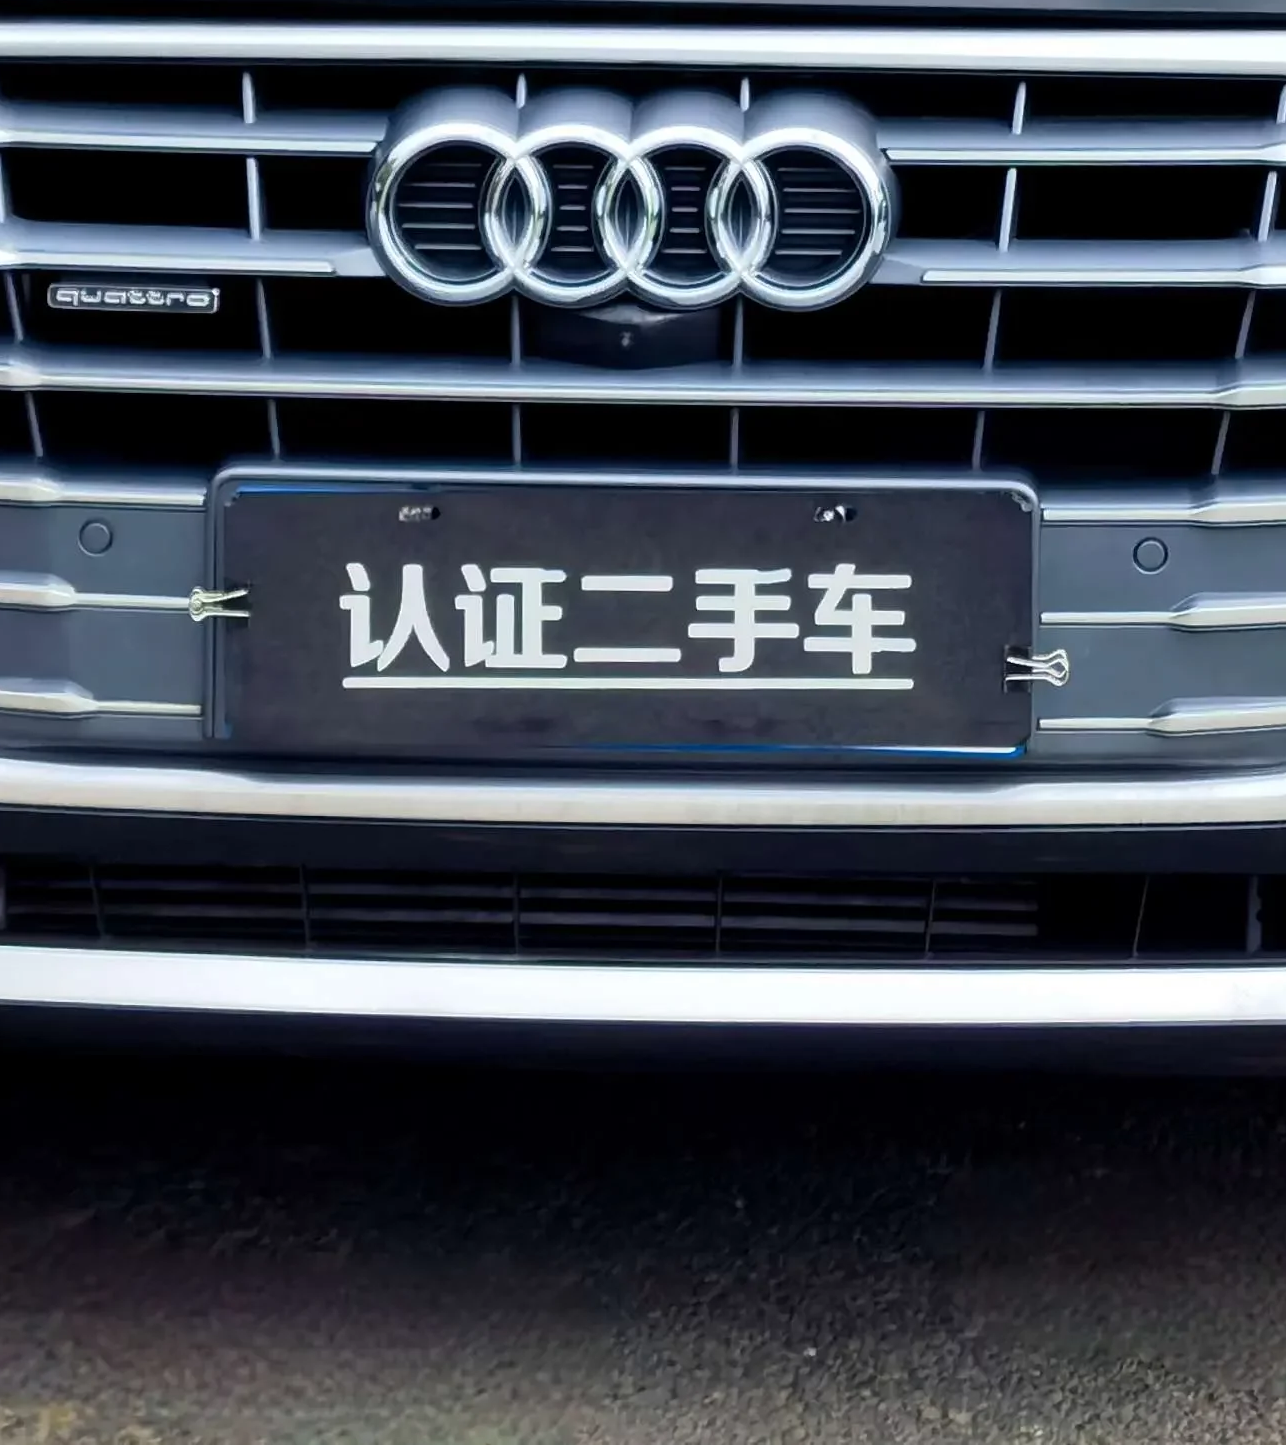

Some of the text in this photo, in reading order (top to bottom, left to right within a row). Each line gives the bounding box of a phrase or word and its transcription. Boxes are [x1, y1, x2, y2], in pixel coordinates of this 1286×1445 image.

[56, 288, 210, 307] quattro
[339, 562, 917, 675] 认证二手车
